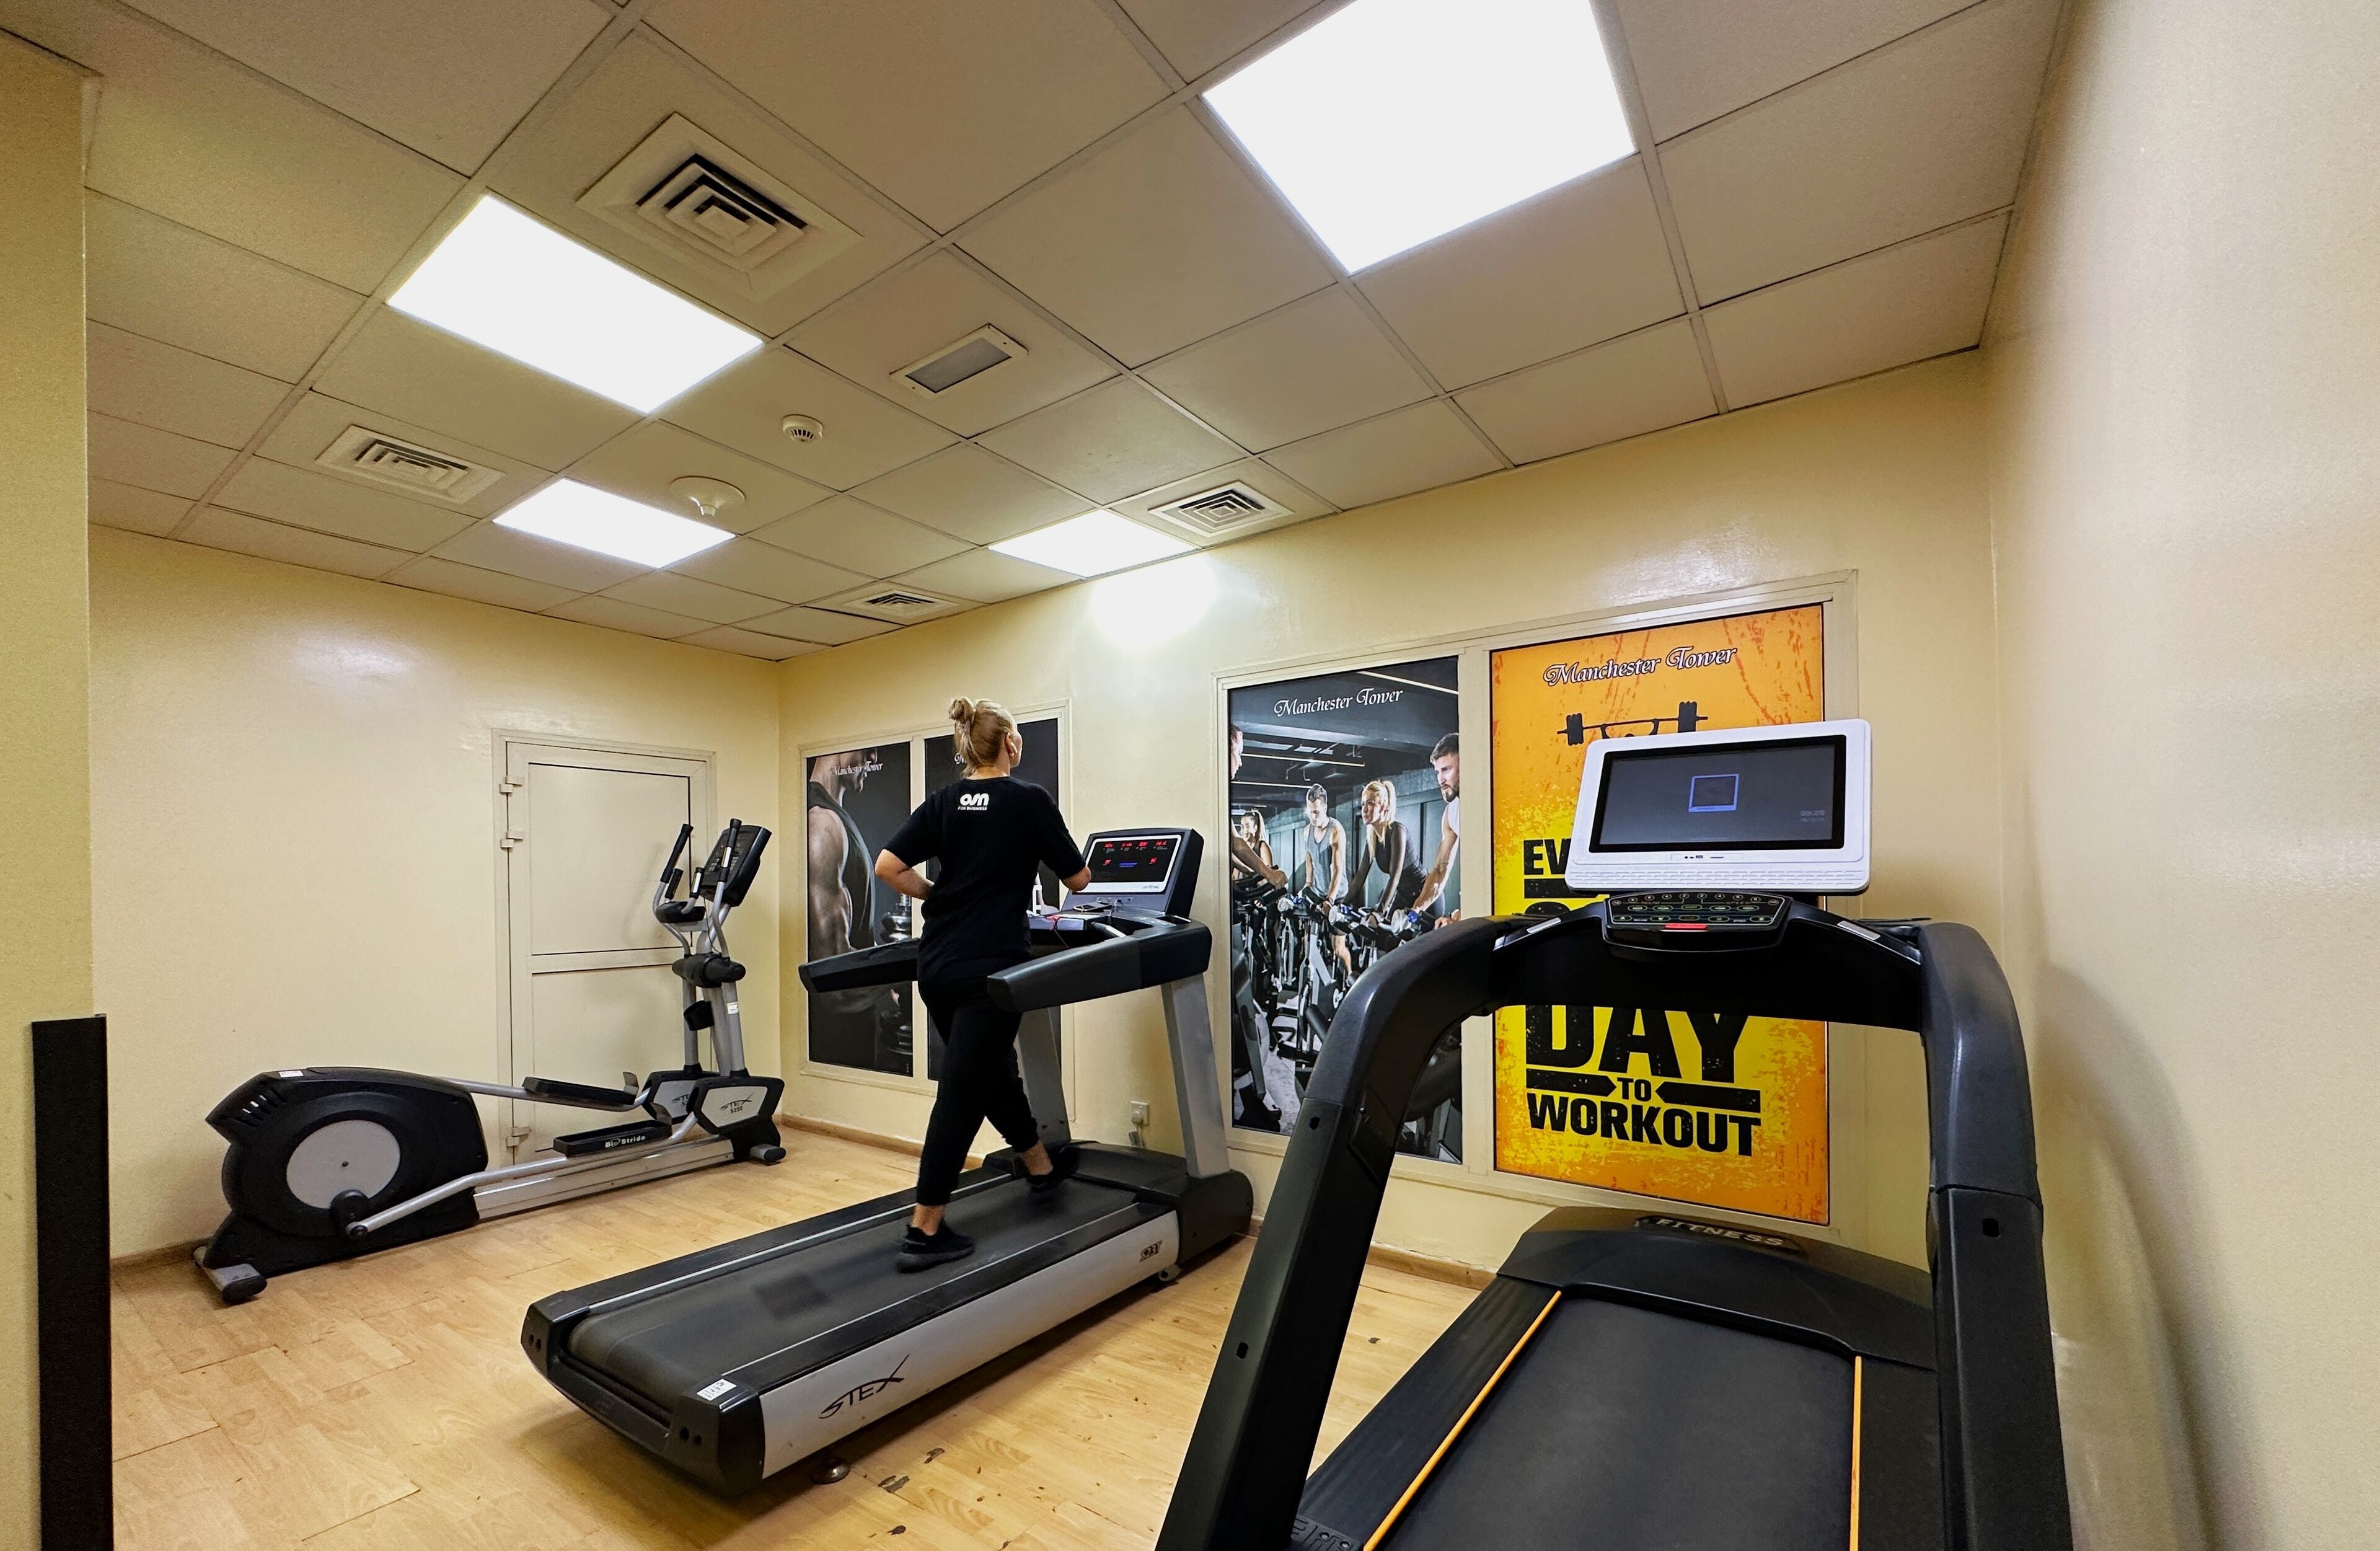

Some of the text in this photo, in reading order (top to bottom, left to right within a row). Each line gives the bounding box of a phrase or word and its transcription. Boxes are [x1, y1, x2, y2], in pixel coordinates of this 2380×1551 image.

[1543, 645, 1738, 686] Manchester Tower
[1274, 687, 1404, 717] Manchester Tower
[1525, 1005, 1750, 1084] DAY
[1616, 1077, 1652, 1102] TO
[1527, 1092, 1761, 1157] WORKOUT
[1656, 1219, 1784, 1245] FITNESS
[818, 1354, 910, 1419] STEX
